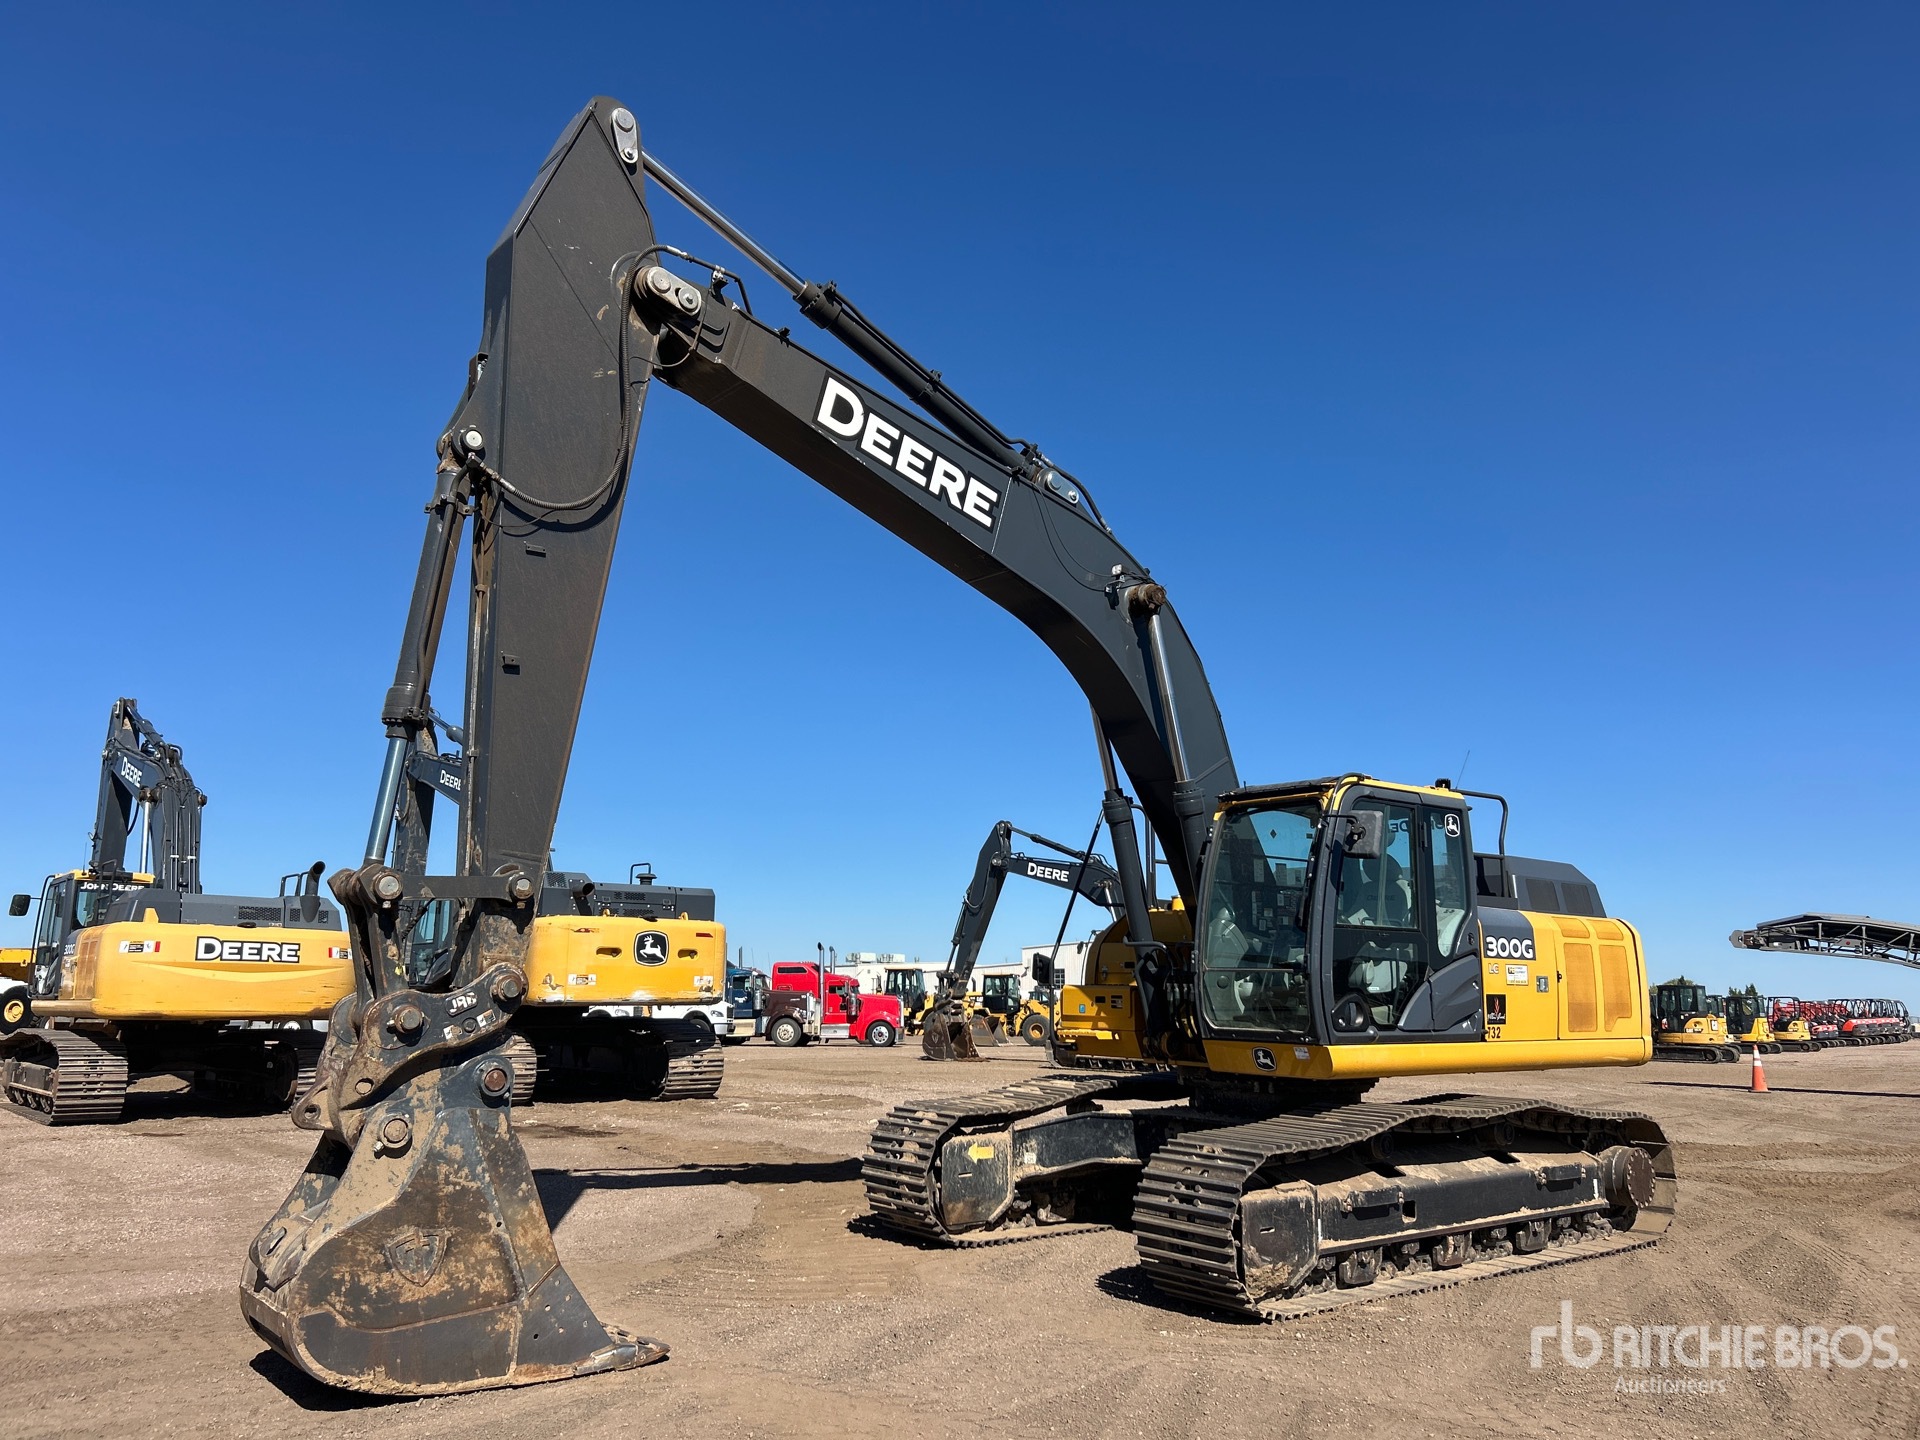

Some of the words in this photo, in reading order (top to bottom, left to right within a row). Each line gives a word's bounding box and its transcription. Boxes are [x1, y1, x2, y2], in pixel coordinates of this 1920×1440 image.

[816, 376, 998, 529] DEERE
[120, 756, 143, 788] DEERE
[1027, 862, 1070, 882] DEERE
[196, 936, 300, 963] DEERE
[1485, 936, 1534, 959] 300G
[1488, 963, 1500, 974] LC
